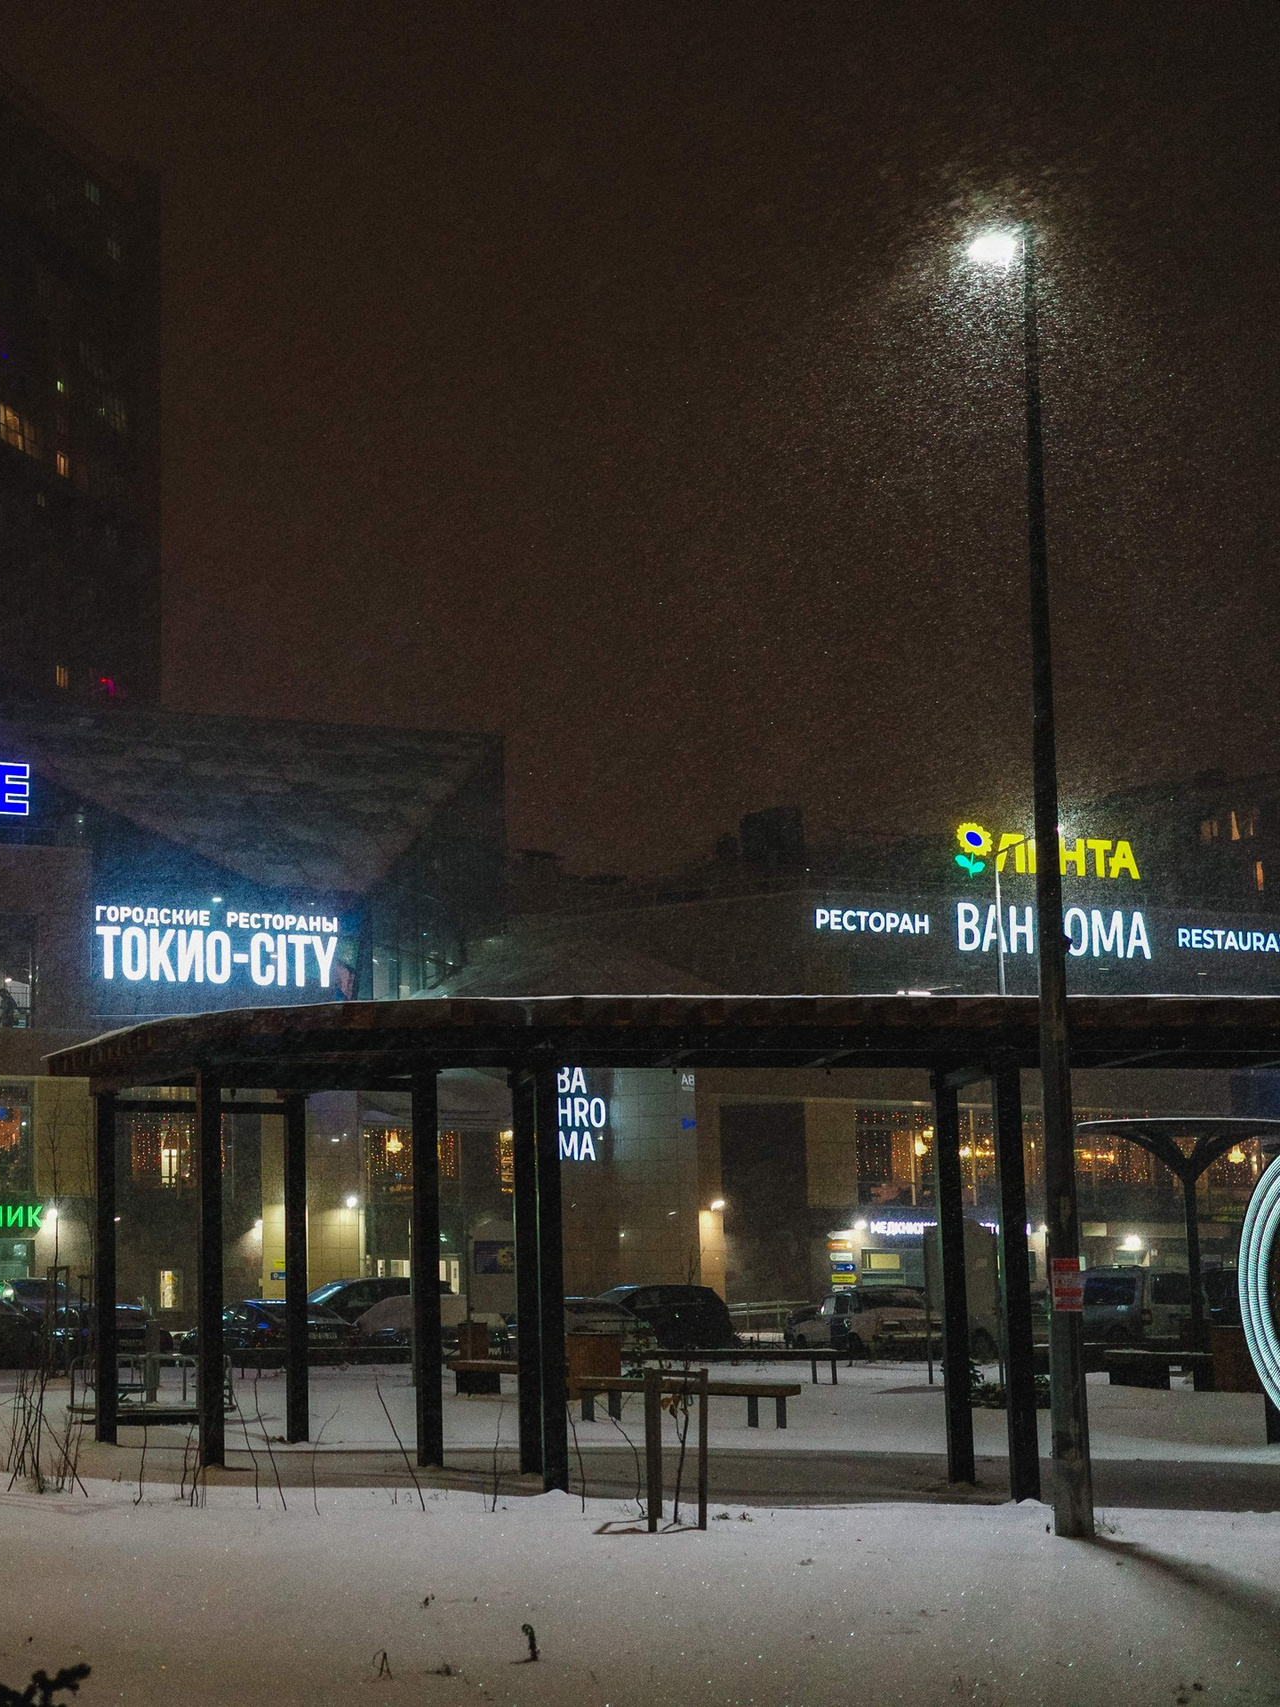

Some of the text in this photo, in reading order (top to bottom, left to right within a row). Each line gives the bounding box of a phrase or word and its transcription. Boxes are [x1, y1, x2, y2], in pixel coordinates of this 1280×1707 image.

[95, 905, 338, 932] ГОРОДСКИЕ РЕСТОРАНЫ
[815, 908, 930, 934] РЕСТОРАН
[957, 902, 1151, 959] BAHOMA
[1177, 928, 1280, 952] RESTAURA
[95, 926, 338, 987] ТОКИО-CITY
[558, 1097, 606, 1128] HRO
[559, 1131, 596, 1161] MA
